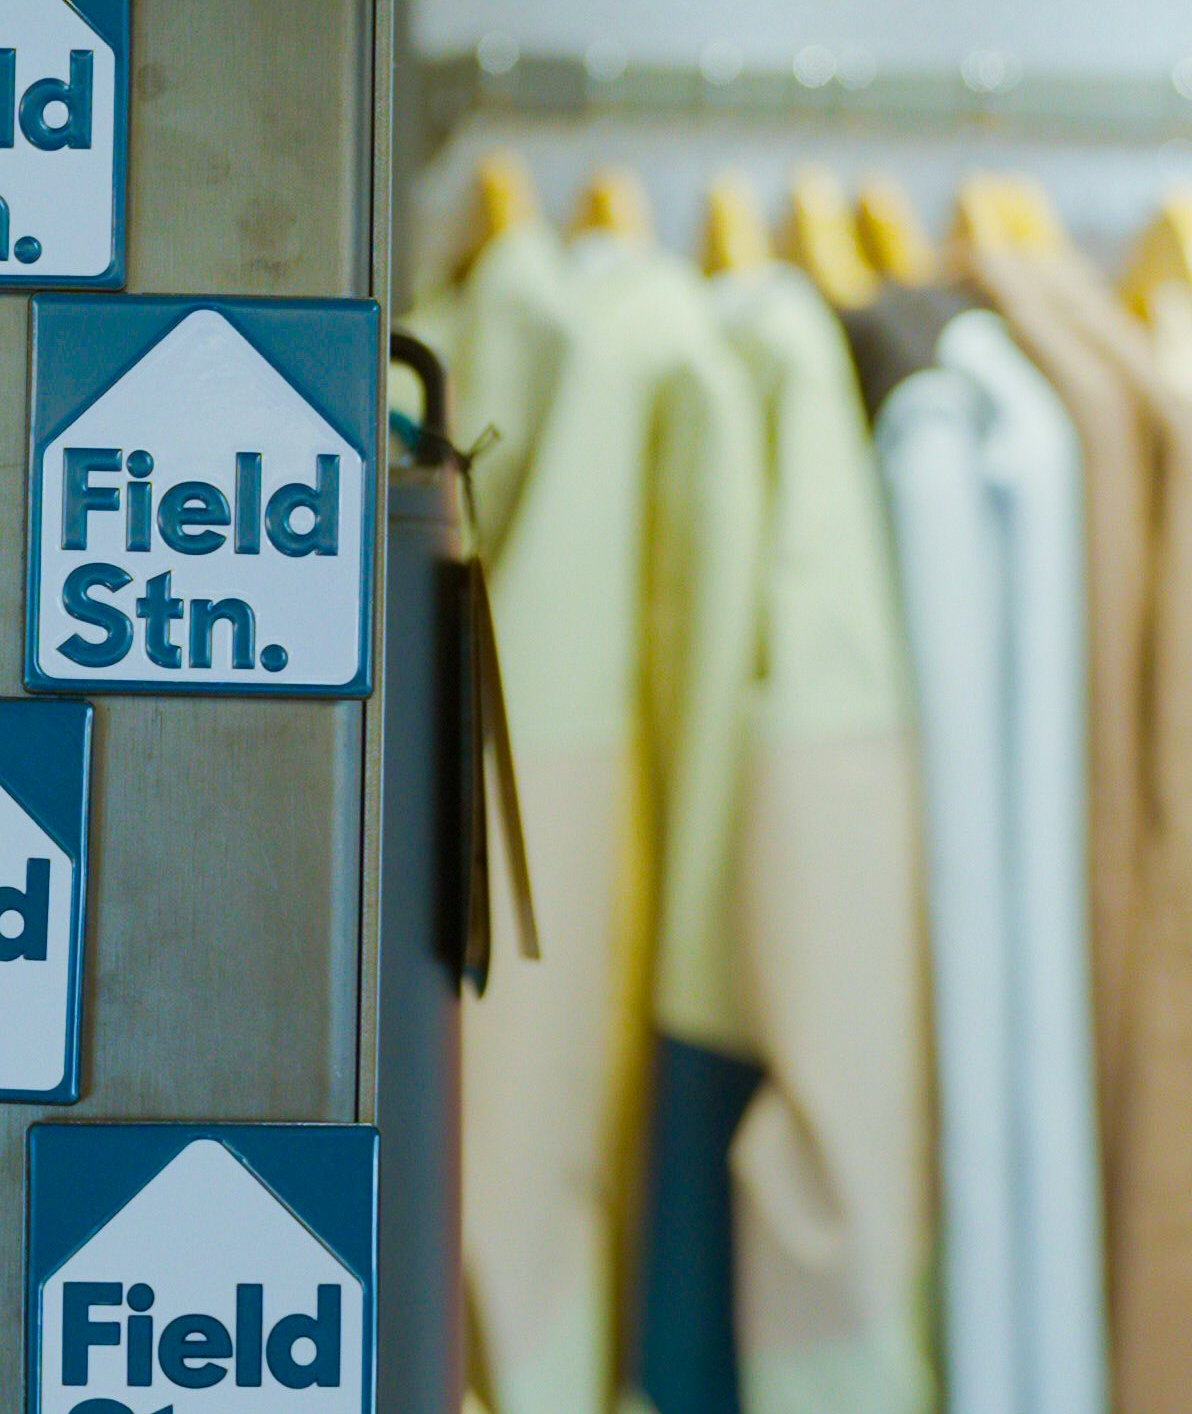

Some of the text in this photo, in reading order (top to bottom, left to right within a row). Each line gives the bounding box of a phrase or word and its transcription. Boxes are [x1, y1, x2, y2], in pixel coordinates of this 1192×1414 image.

[61, 447, 339, 557] Field
[56, 563, 288, 672] Stn.
[62, 1282, 341, 1389] Field
